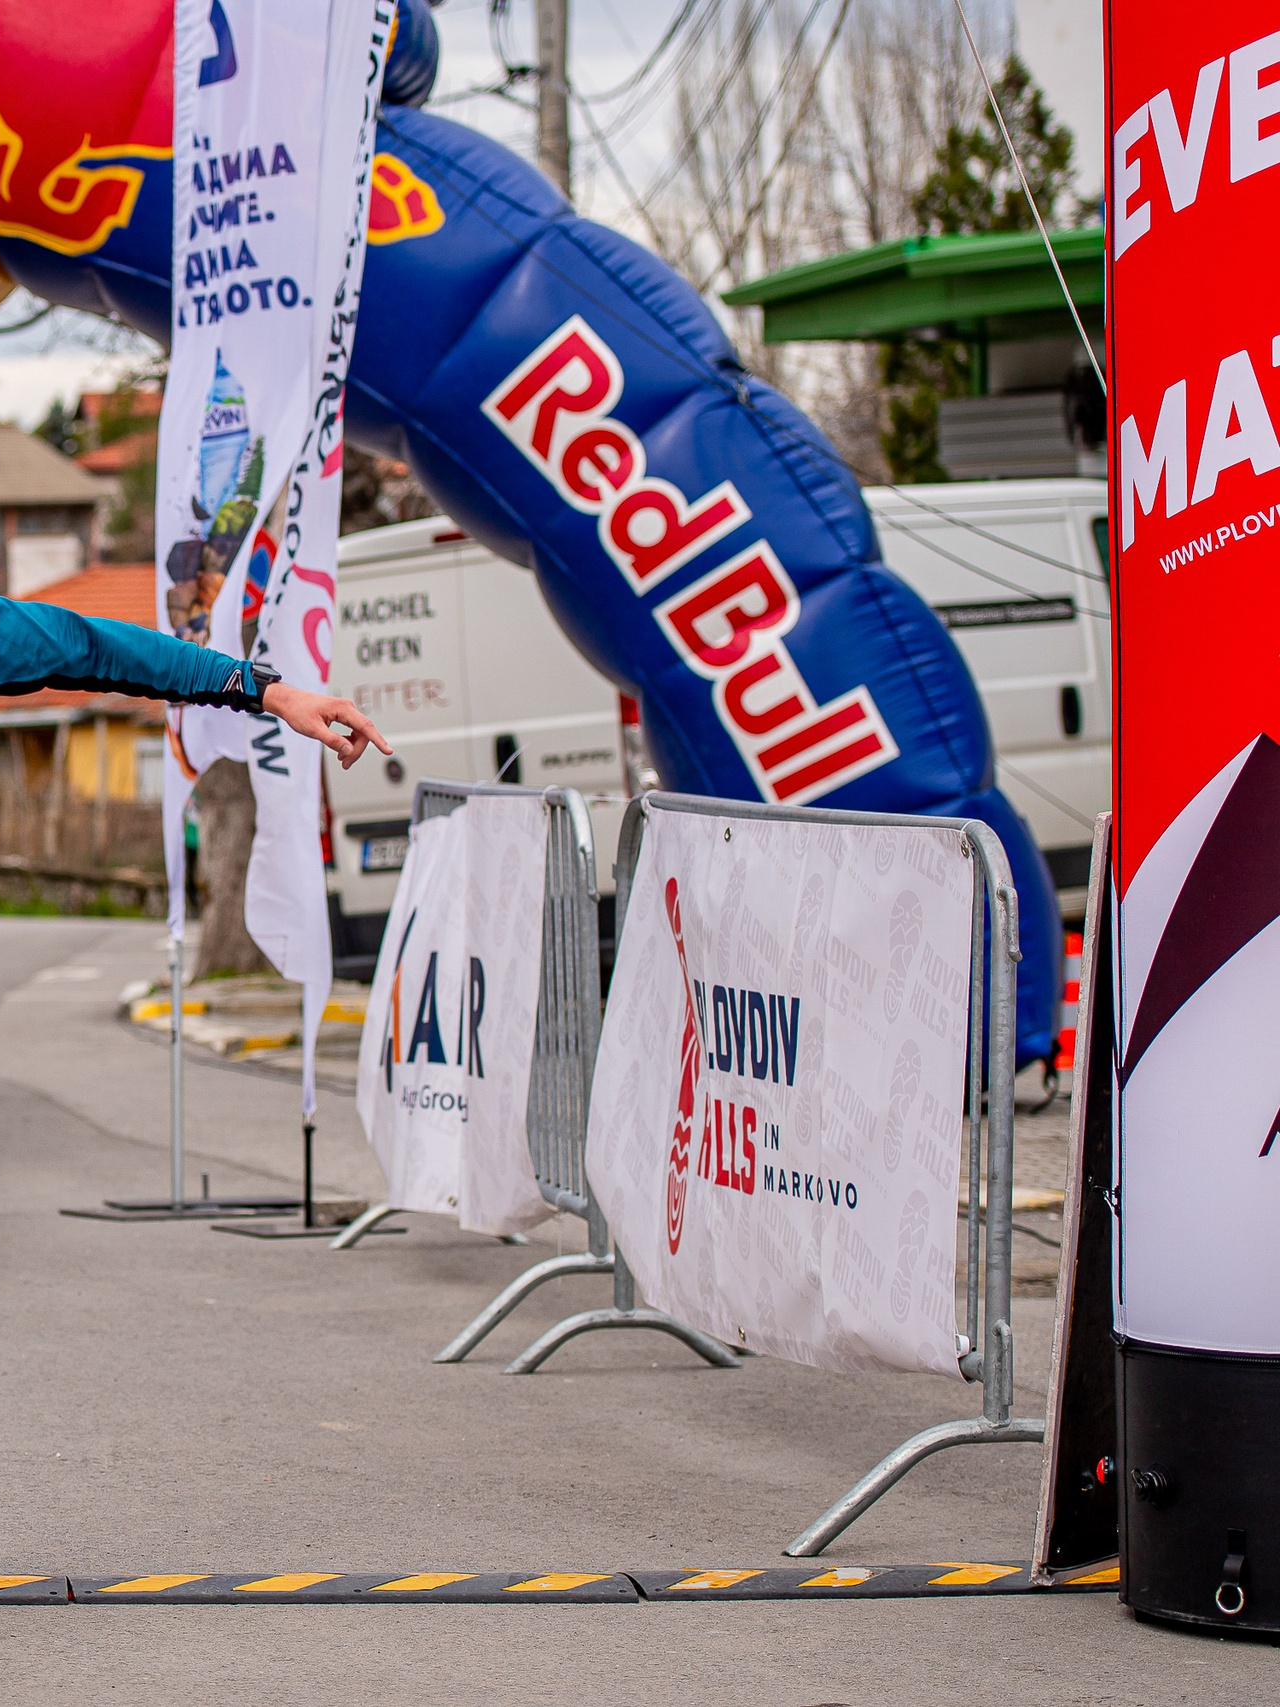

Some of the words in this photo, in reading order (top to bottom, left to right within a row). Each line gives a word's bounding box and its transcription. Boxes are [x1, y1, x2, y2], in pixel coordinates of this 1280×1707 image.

[1121, 334, 1280, 553] MA
[496, 331, 735, 580] Red
[667, 555, 883, 800] Bull
[341, 592, 436, 626] KACHEL
[764, 1122, 779, 1151] IN
[763, 1164, 858, 1209] MARKOVO
